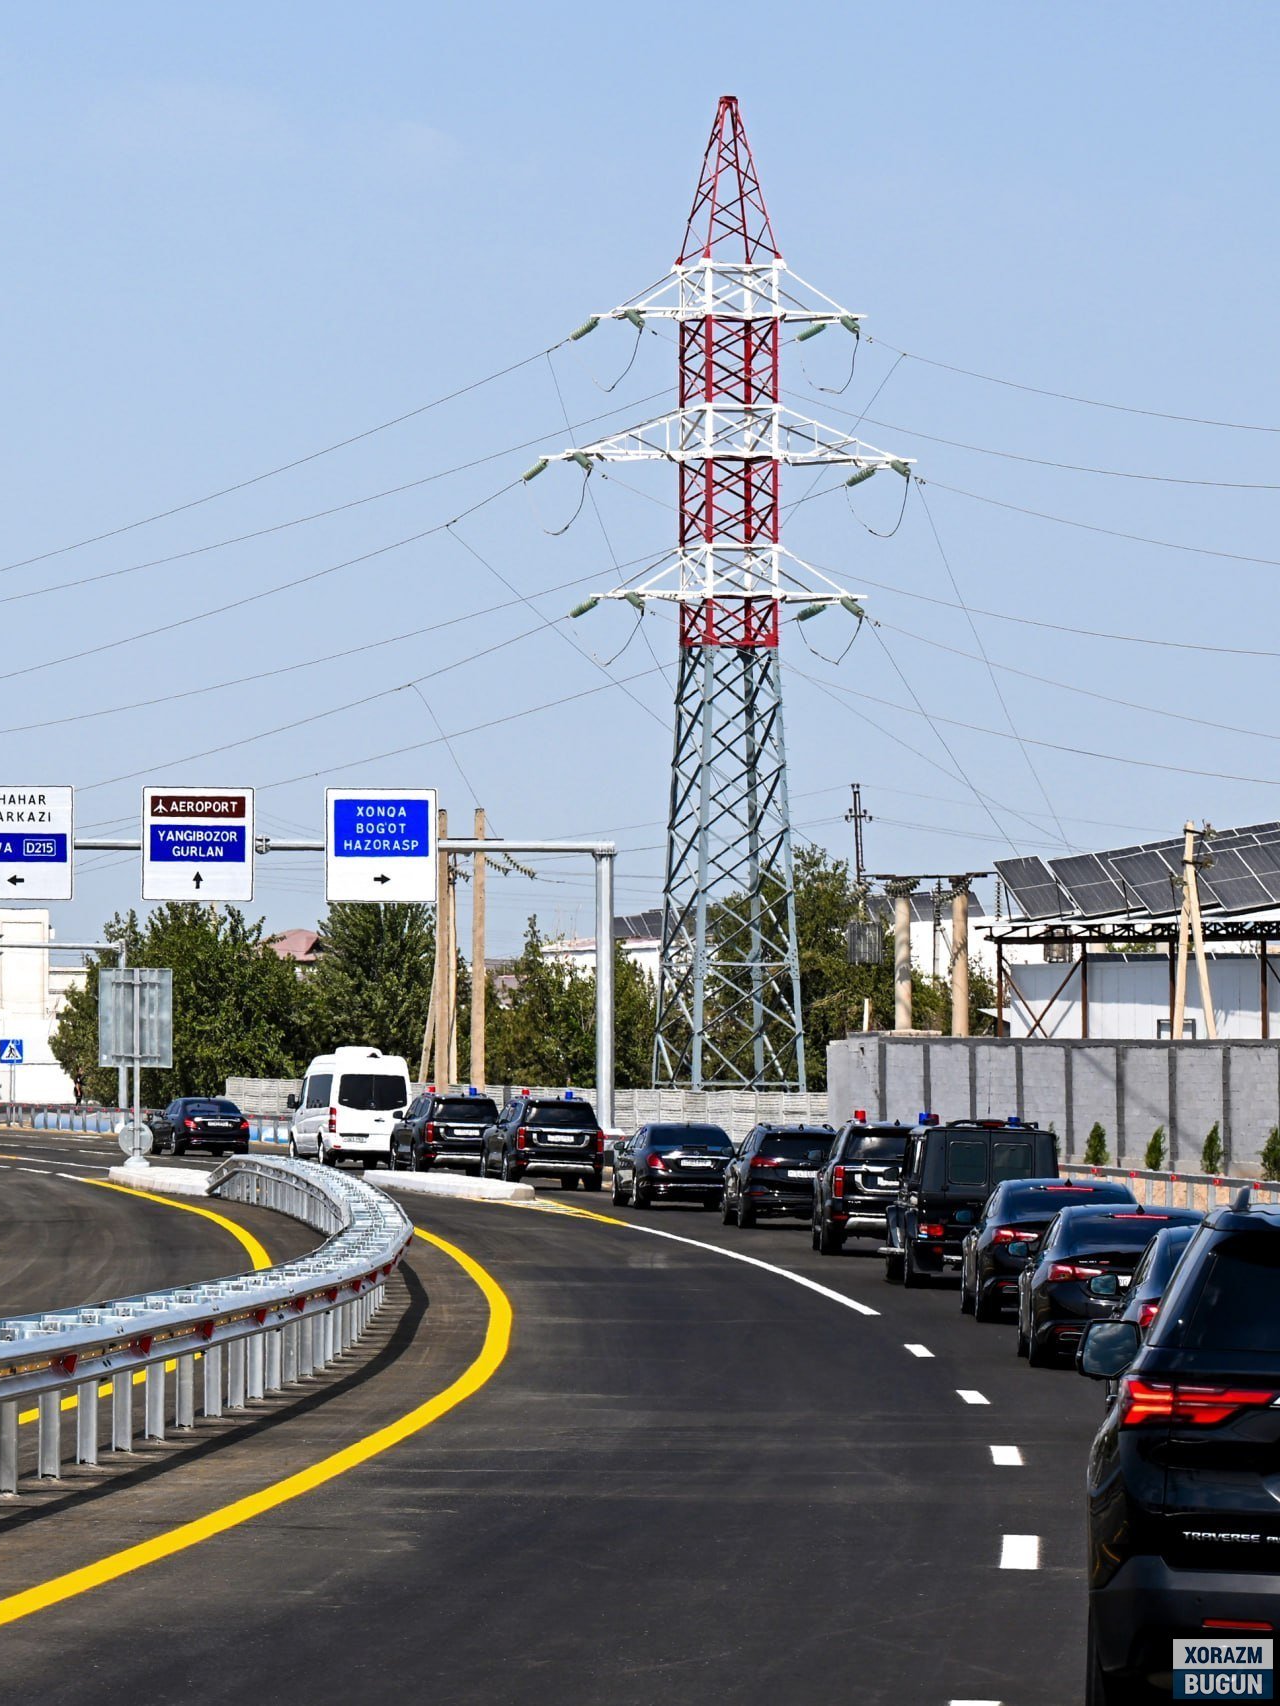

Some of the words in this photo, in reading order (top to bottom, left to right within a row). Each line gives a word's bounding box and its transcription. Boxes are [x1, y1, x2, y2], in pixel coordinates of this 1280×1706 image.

[169, 800, 238, 813] AEROPORT
[357, 806, 407, 818] XONQA
[157, 830, 238, 843] YANGIBOZOR
[26, 842, 53, 854] D215
[343, 839, 419, 851] HAZORASP
[172, 845, 224, 858] GURLAN
[1182, 1531, 1261, 1543] TRAVERSE
